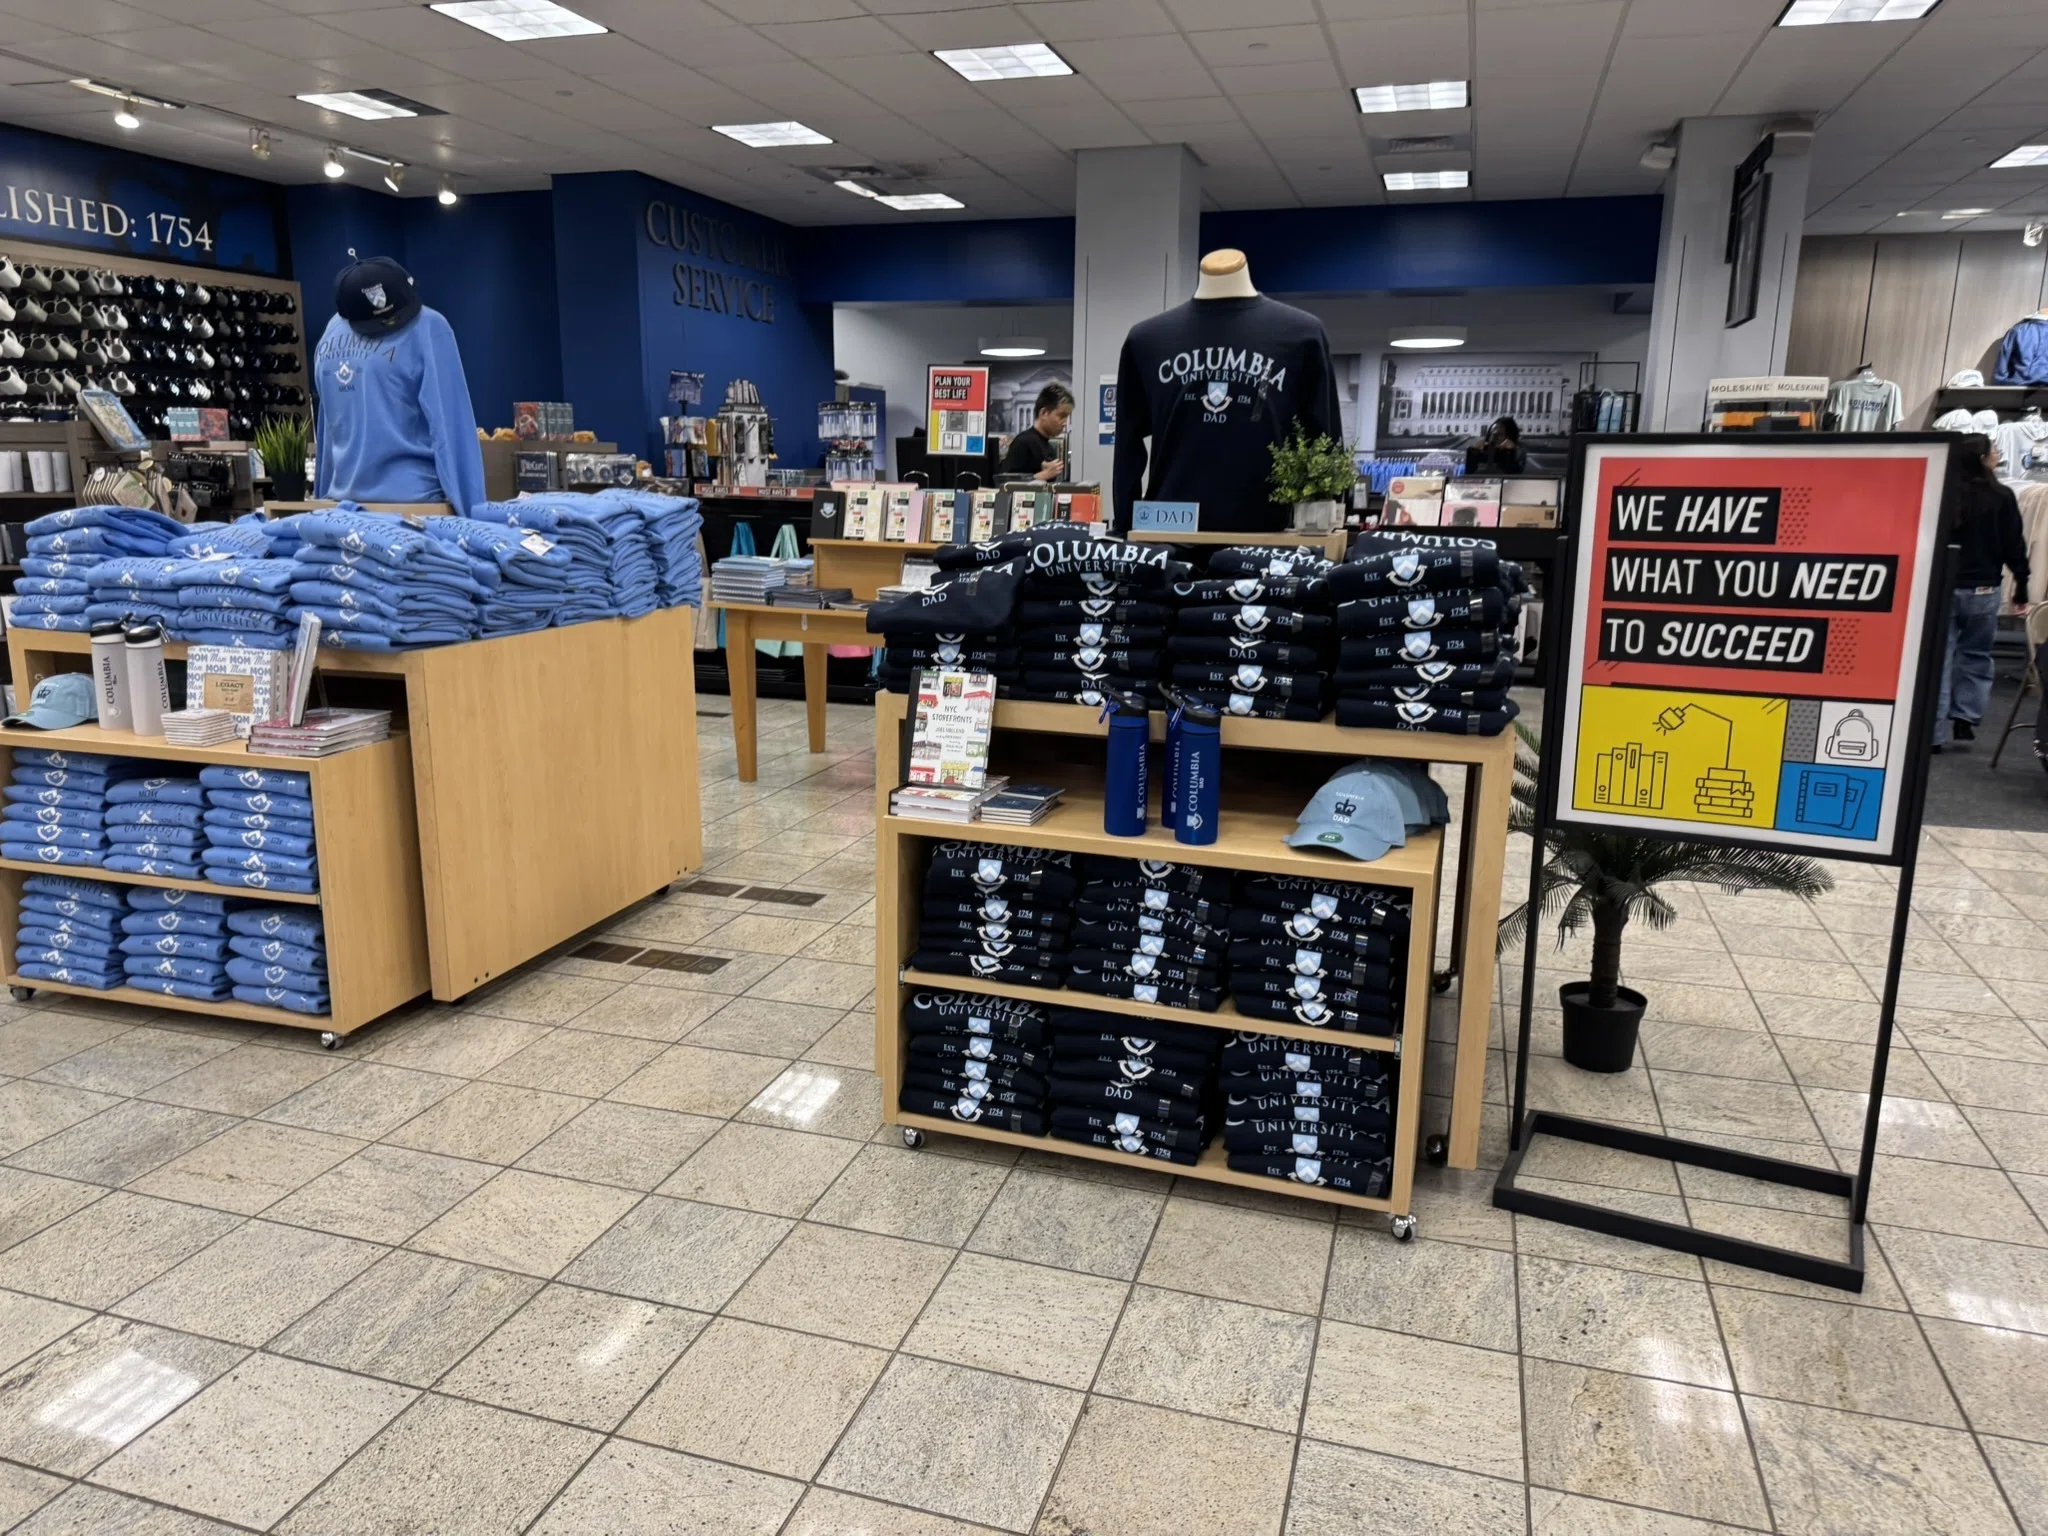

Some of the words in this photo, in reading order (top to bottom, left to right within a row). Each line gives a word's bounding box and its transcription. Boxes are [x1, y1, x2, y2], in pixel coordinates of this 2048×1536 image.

[0, 186, 137, 238] ISHED:
[147, 212, 213, 251] 1754
[673, 262, 775, 324] SERVICE
[1158, 348, 1287, 392] COLUMBIA
[935, 376, 951, 386] PLAN
[953, 376, 971, 386] YOUR
[1181, 369, 1261, 388] UNIVERSITY
[934, 389, 950, 398] BEST
[952, 389, 966, 399] LIFE
[1711, 383, 1770, 394] MOLESKINE
[1778, 383, 1825, 393] MOLESKINE
[1203, 413, 1227, 424] DAD
[1156, 509, 1194, 525] DAD
[1616, 493, 1665, 532] WE
[1674, 495, 1769, 535] HAVE
[1372, 531, 1497, 550] COLUMBI
[976, 551, 1000, 561] DAD
[1045, 560, 1138, 577] UNIVERSITY
[1241, 562, 1255, 570] EST.
[1364, 573, 1380, 581] EST.
[1434, 557, 1452, 567] 1754
[1610, 553, 1702, 596] WHAT
[1715, 561, 1779, 598] YOU
[1789, 563, 1888, 602] NEED
[922, 593, 947, 607] DAD
[1202, 590, 1222, 599] EST.
[1269, 587, 1291, 596] 1754
[1368, 588, 1475, 608] UNIVERSITY
[195, 614, 258, 628] UNIVERSITY
[1212, 612, 1226, 620] EST.
[1379, 617, 1395, 626] EST.
[1451, 607, 1469, 616] 1754
[1055, 634, 1068, 642] EST.
[1605, 618, 1645, 656] TO
[1657, 621, 1814, 665] SUCCEED
[913, 649, 925, 657] EST.
[1229, 648, 1257, 659] DAD
[1375, 648, 1391, 656] EST.
[1446, 641, 1465, 649] 1754
[230, 656, 250, 664] MOM
[1462, 663, 1481, 671] 1754
[188, 673, 204, 681] MO
[250, 667, 271, 675] MOM
[1210, 672, 1223, 680] EST.
[102, 656, 115, 704] COLUMBIA
[156, 661, 168, 709] COLUMBIA
[932, 714, 972, 723] STOREFRONTS
[1442, 709, 1462, 718] 1754
[1137, 743, 1146, 804] COLUMBIA
[1188, 751, 1200, 812] COLUMBIA
[1333, 815, 1350, 823] DAD
[932, 841, 1072, 869] OLUMBIA
[947, 850, 1040, 866] UNIVERSITY
[951, 868, 965, 877] EST.
[1181, 866, 1197, 876] 1754
[1278, 881, 1381, 909] UNIVERSITY
[958, 904, 972, 912] EST.
[1017, 910, 1033, 918] 1754
[1281, 901, 1295, 910] EST.
[1348, 915, 1366, 925] 1754
[958, 921, 972, 929] EST.
[1260, 914, 1277, 923] EST.
[1329, 930, 1349, 941] 1754
[1112, 942, 1126, 950] EST.
[1103, 960, 1118, 969] EST.
[1167, 970, 1184, 979] 1754
[1266, 957, 1280, 967] EST.
[1265, 982, 1280, 991] EST.
[913, 993, 1045, 1022] COLUMBI
[1272, 1000, 1287, 1009] EST.
[939, 1005, 1026, 1028] UNIVERSITY
[944, 1043, 957, 1052] EST.
[1003, 1054, 1017, 1063] 1754
[1248, 1040, 1350, 1059] UNIVERSITY
[943, 1080, 956, 1090] EST.
[1261, 1071, 1362, 1089] UNIVERSITY
[1105, 1086, 1132, 1100] DAD
[933, 1101, 945, 1110] EST.
[988, 1108, 1003, 1117] 1754
[1258, 1095, 1360, 1115] UNIVERSITY
[1089, 1117, 1102, 1127] EST.
[1151, 1132, 1165, 1141] 1754
[1256, 1121, 1358, 1141] UNIVERSITY
[1093, 1134, 1107, 1143] EST.
[1267, 1167, 1281, 1176] EST.
[1334, 1178, 1351, 1187] 1754
